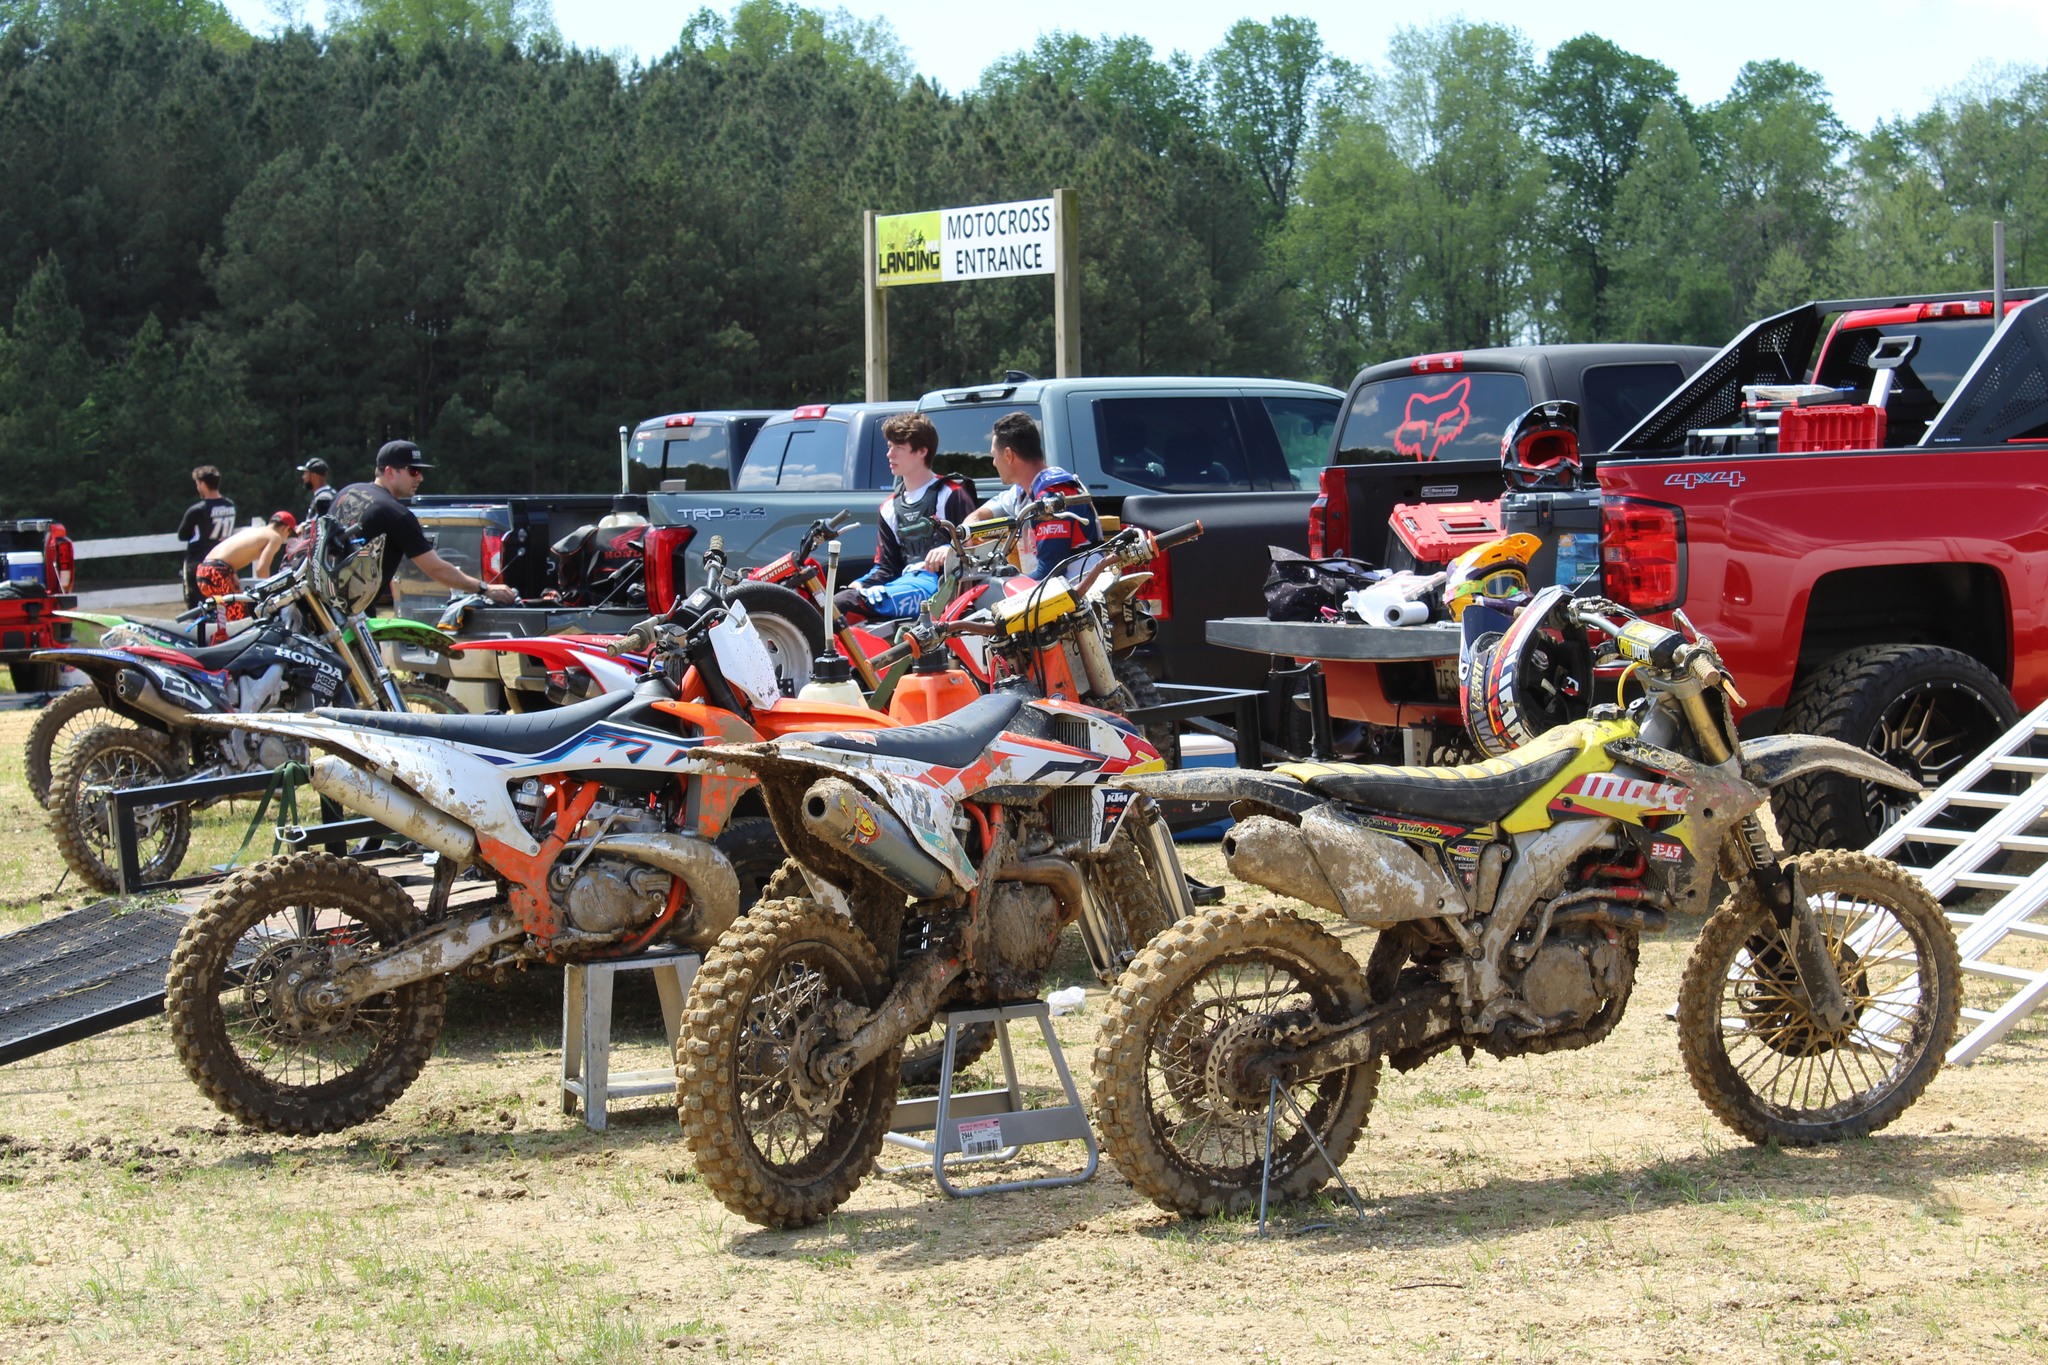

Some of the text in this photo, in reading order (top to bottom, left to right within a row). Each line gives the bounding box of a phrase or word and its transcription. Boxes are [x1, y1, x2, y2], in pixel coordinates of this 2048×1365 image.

[947, 205, 1050, 241] MOTOCROSS
[879, 250, 940, 274] LANDING
[956, 243, 1042, 275] ENTRANCE
[677, 508, 724, 521] TRD
[604, 551, 642, 559] HOND
[899, 594, 922, 616] FLY
[592, 637, 617, 645] HON
[274, 646, 344, 681] HONDA
[1106, 792, 1128, 803] KTM
[1397, 822, 1424, 834] Twin
[1423, 826, 1441, 837] Air
[1651, 843, 1682, 858] ヨシムラ
